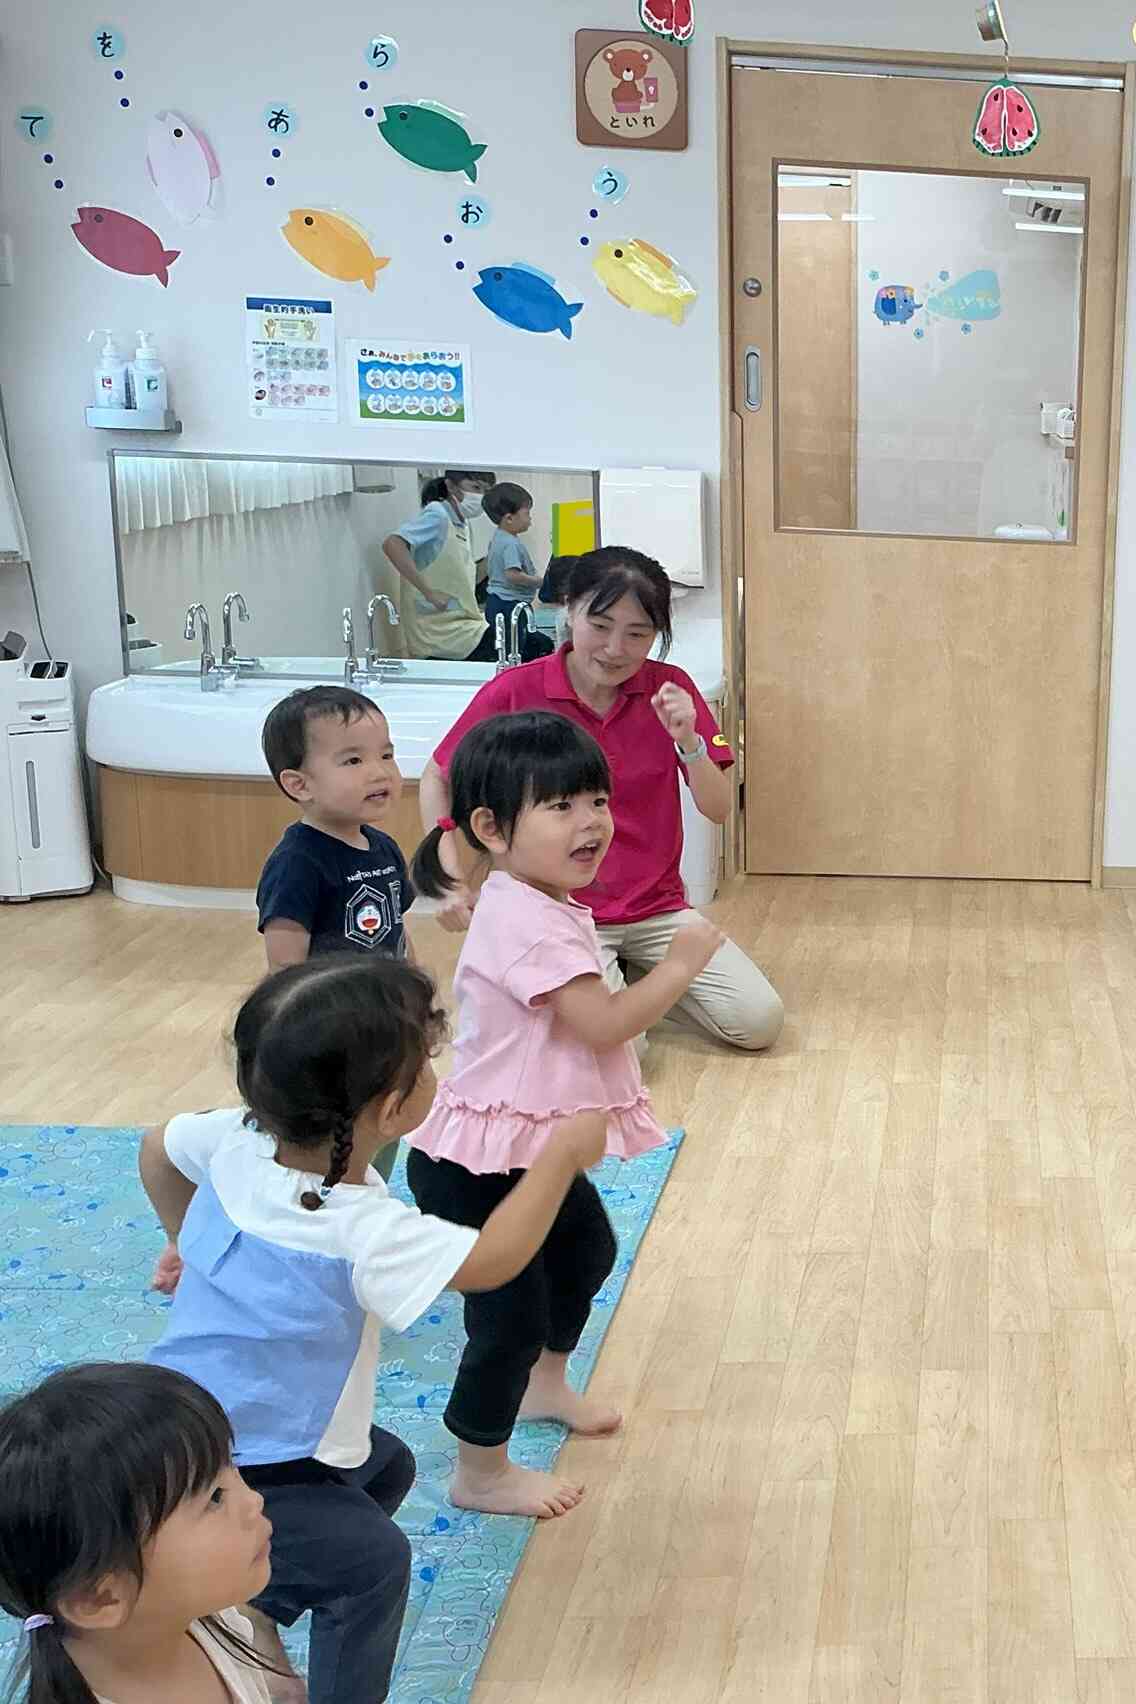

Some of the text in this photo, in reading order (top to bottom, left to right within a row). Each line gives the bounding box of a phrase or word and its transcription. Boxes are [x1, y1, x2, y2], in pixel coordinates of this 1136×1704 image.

[96, 31, 115, 58] を
[372, 43, 389, 68] ら
[20, 115, 44, 138] て
[267, 108, 290, 134] あ
[610, 115, 656, 129] といれ
[601, 171, 618, 196] う
[460, 200, 484, 224] お
